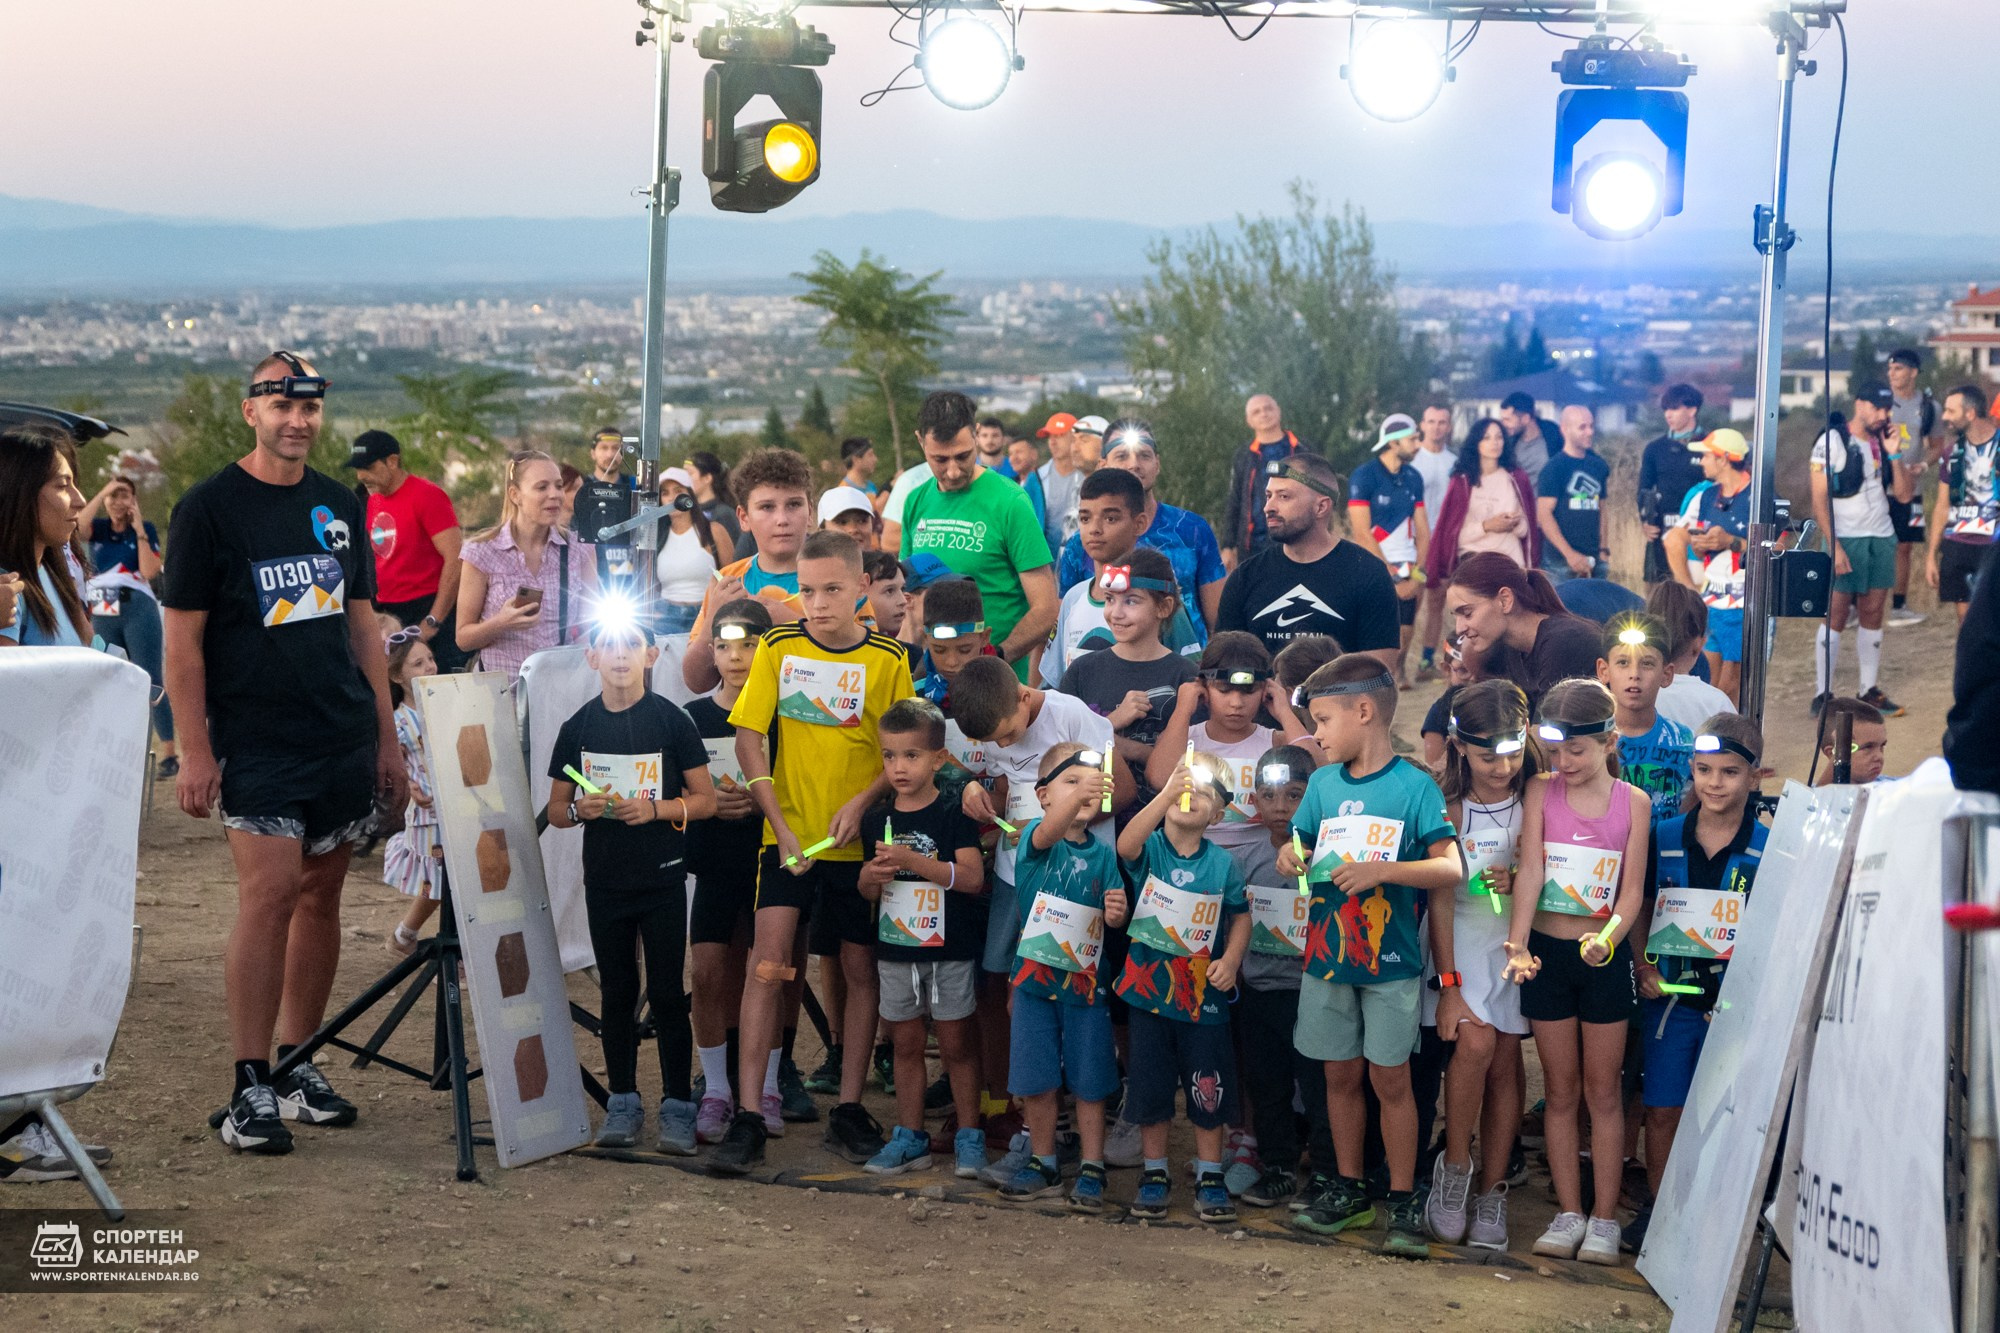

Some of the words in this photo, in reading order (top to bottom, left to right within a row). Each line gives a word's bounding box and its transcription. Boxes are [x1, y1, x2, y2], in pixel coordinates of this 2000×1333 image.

[948, 534, 984, 552] 2025
[259, 560, 313, 591] 0130
[1266, 632, 1291, 640] NIKE
[794, 668, 816, 677] PLOVDIV
[837, 670, 861, 693] 42
[828, 696, 859, 710] KIDS
[635, 760, 658, 784] 74
[628, 789, 656, 801] KIDS
[1235, 793, 1256, 806] KID
[1329, 827, 1347, 835] PLOVDIV
[1366, 823, 1397, 847] 82
[1357, 849, 1390, 862] KIDS
[1548, 855, 1568, 863] PLOVDIV
[1592, 857, 1618, 882] 47
[1154, 891, 1174, 905] PLOVDIV
[1581, 884, 1611, 900] KIDS
[914, 888, 940, 912] 79
[1046, 907, 1070, 920] PLOVDIV
[1191, 901, 1218, 925] 80
[1711, 898, 1740, 924] 48
[907, 916, 938, 929] KIDS
[1181, 927, 1212, 942] KIDS
[1287, 924, 1309, 938] KID
[1704, 926, 1737, 941] KIDS
[1075, 942, 1099, 957] KIDS
